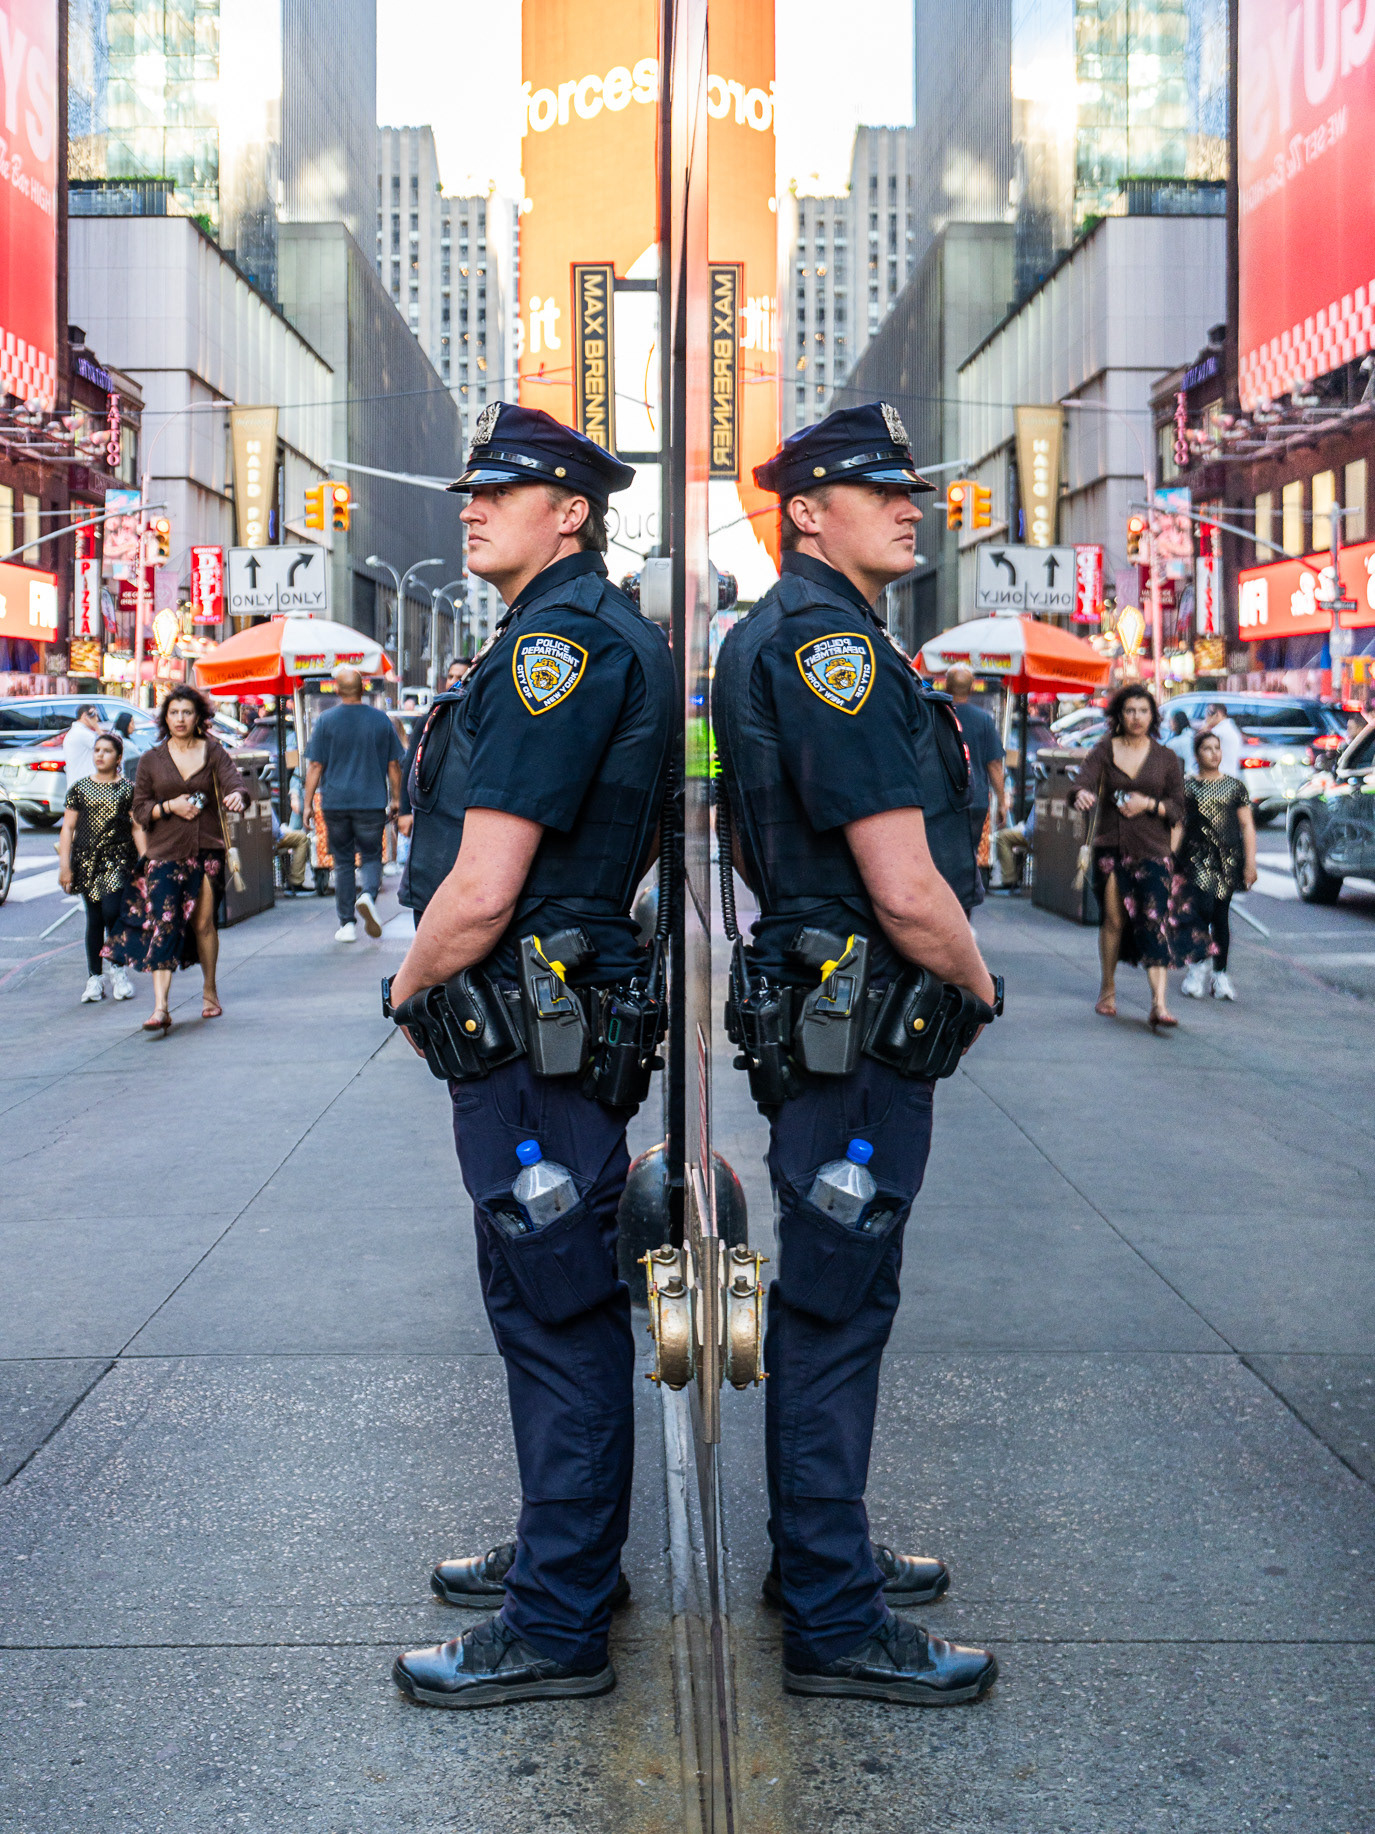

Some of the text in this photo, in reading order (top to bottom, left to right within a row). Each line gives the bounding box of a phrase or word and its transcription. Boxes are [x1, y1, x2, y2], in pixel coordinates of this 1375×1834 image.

[583, 274, 605, 335] MAX
[107, 393, 121, 466] TATTOO
[246, 440, 261, 498] HARD
[246, 507, 261, 549] ROC
[81, 562, 91, 634] PIZZA
[198, 553, 218, 616] DELI
[232, 593, 274, 608] ONLY
[280, 591, 322, 604] ONLY
[294, 653, 326, 670] NUTS
[521, 646, 580, 667] DEPARTMENT
[536, 639, 571, 654] POLICE
[517, 665, 533, 699] CITY OF
[543, 672, 579, 707] NEW YORK
